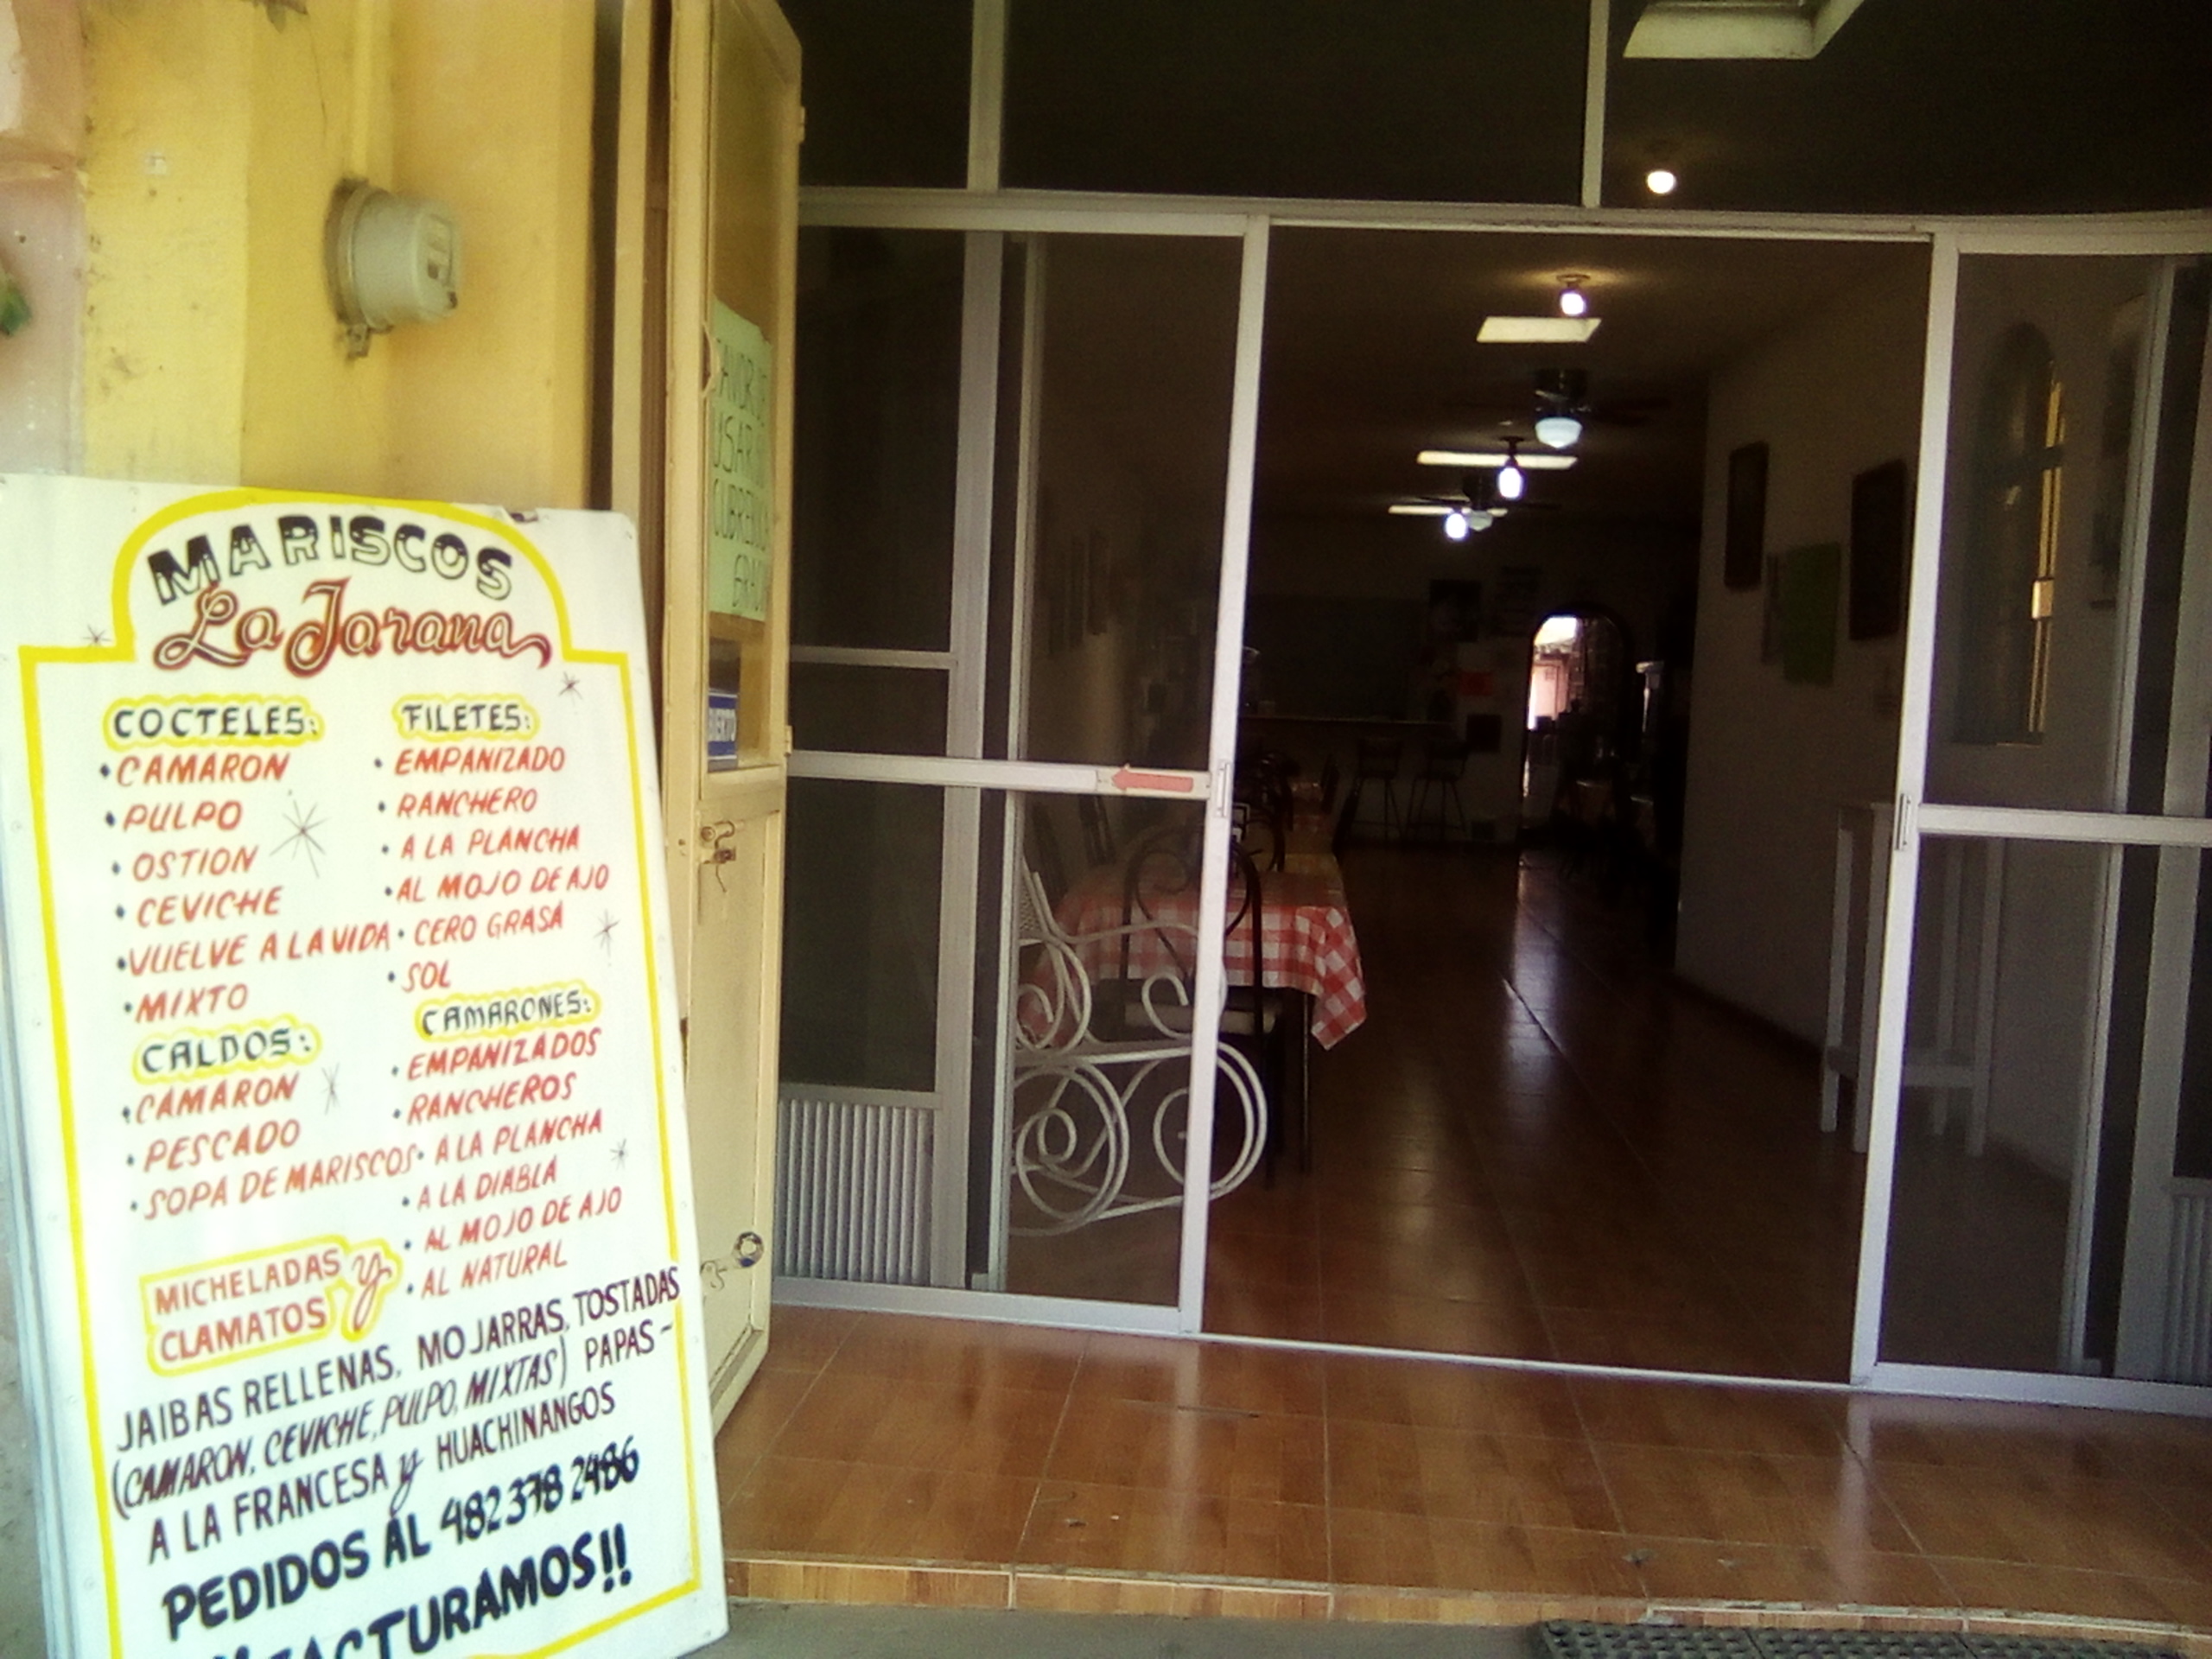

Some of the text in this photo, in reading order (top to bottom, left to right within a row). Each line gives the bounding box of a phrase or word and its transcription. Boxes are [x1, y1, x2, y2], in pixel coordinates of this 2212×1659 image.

[148, 514, 512, 601] MARISCOS
[153, 584, 283, 671] La
[117, 753, 290, 787] CAMARON
[394, 746, 566, 776] EMPANIZADO
[123, 800, 243, 833] PULPO
[397, 786, 537, 818] RANCHERO
[132, 846, 258, 882] OSTION
[401, 824, 580, 860] A LA PLANCHA
[137, 886, 283, 928] CEVICHE
[397, 864, 609, 903] AL MOJO DE AJO
[129, 921, 390, 976] VUELVE A LA VIDA
[414, 900, 563, 946] CERO GRASA
[135, 983, 248, 1023] MIXTO
[403, 960, 451, 993] SOL
[407, 1027, 601, 1081] EMPANIZADOS
[136, 1072, 299, 1124] CAMARON
[407, 1071, 577, 1125] RANCHEROS
[143, 1119, 301, 1173] PESCADO
[435, 1109, 602, 1165] A LA PLANCHA
[144, 1143, 416, 1220] SOPA DE MARISCOS
[417, 1155, 556, 1210] A LA DIABLA
[425, 1186, 622, 1252] AL MOJO DE AJO
[155, 1249, 341, 1315] MICHELADAS
[422, 1240, 568, 1299] AL NATURAL
[161, 1297, 327, 1362] CLAMATOS
[118, 1386, 233, 1452] JAIBAS
[572, 1266, 680, 1326] TOSTADAS
[149, 1517, 170, 1565] A
[182, 1503, 222, 1554] LA
[233, 1452, 389, 1536] FRANCESA
[436, 1381, 617, 1471] HUACHINANGOS
[161, 1529, 371, 1643] PEDIDOS
[385, 1512, 432, 1568] AL
